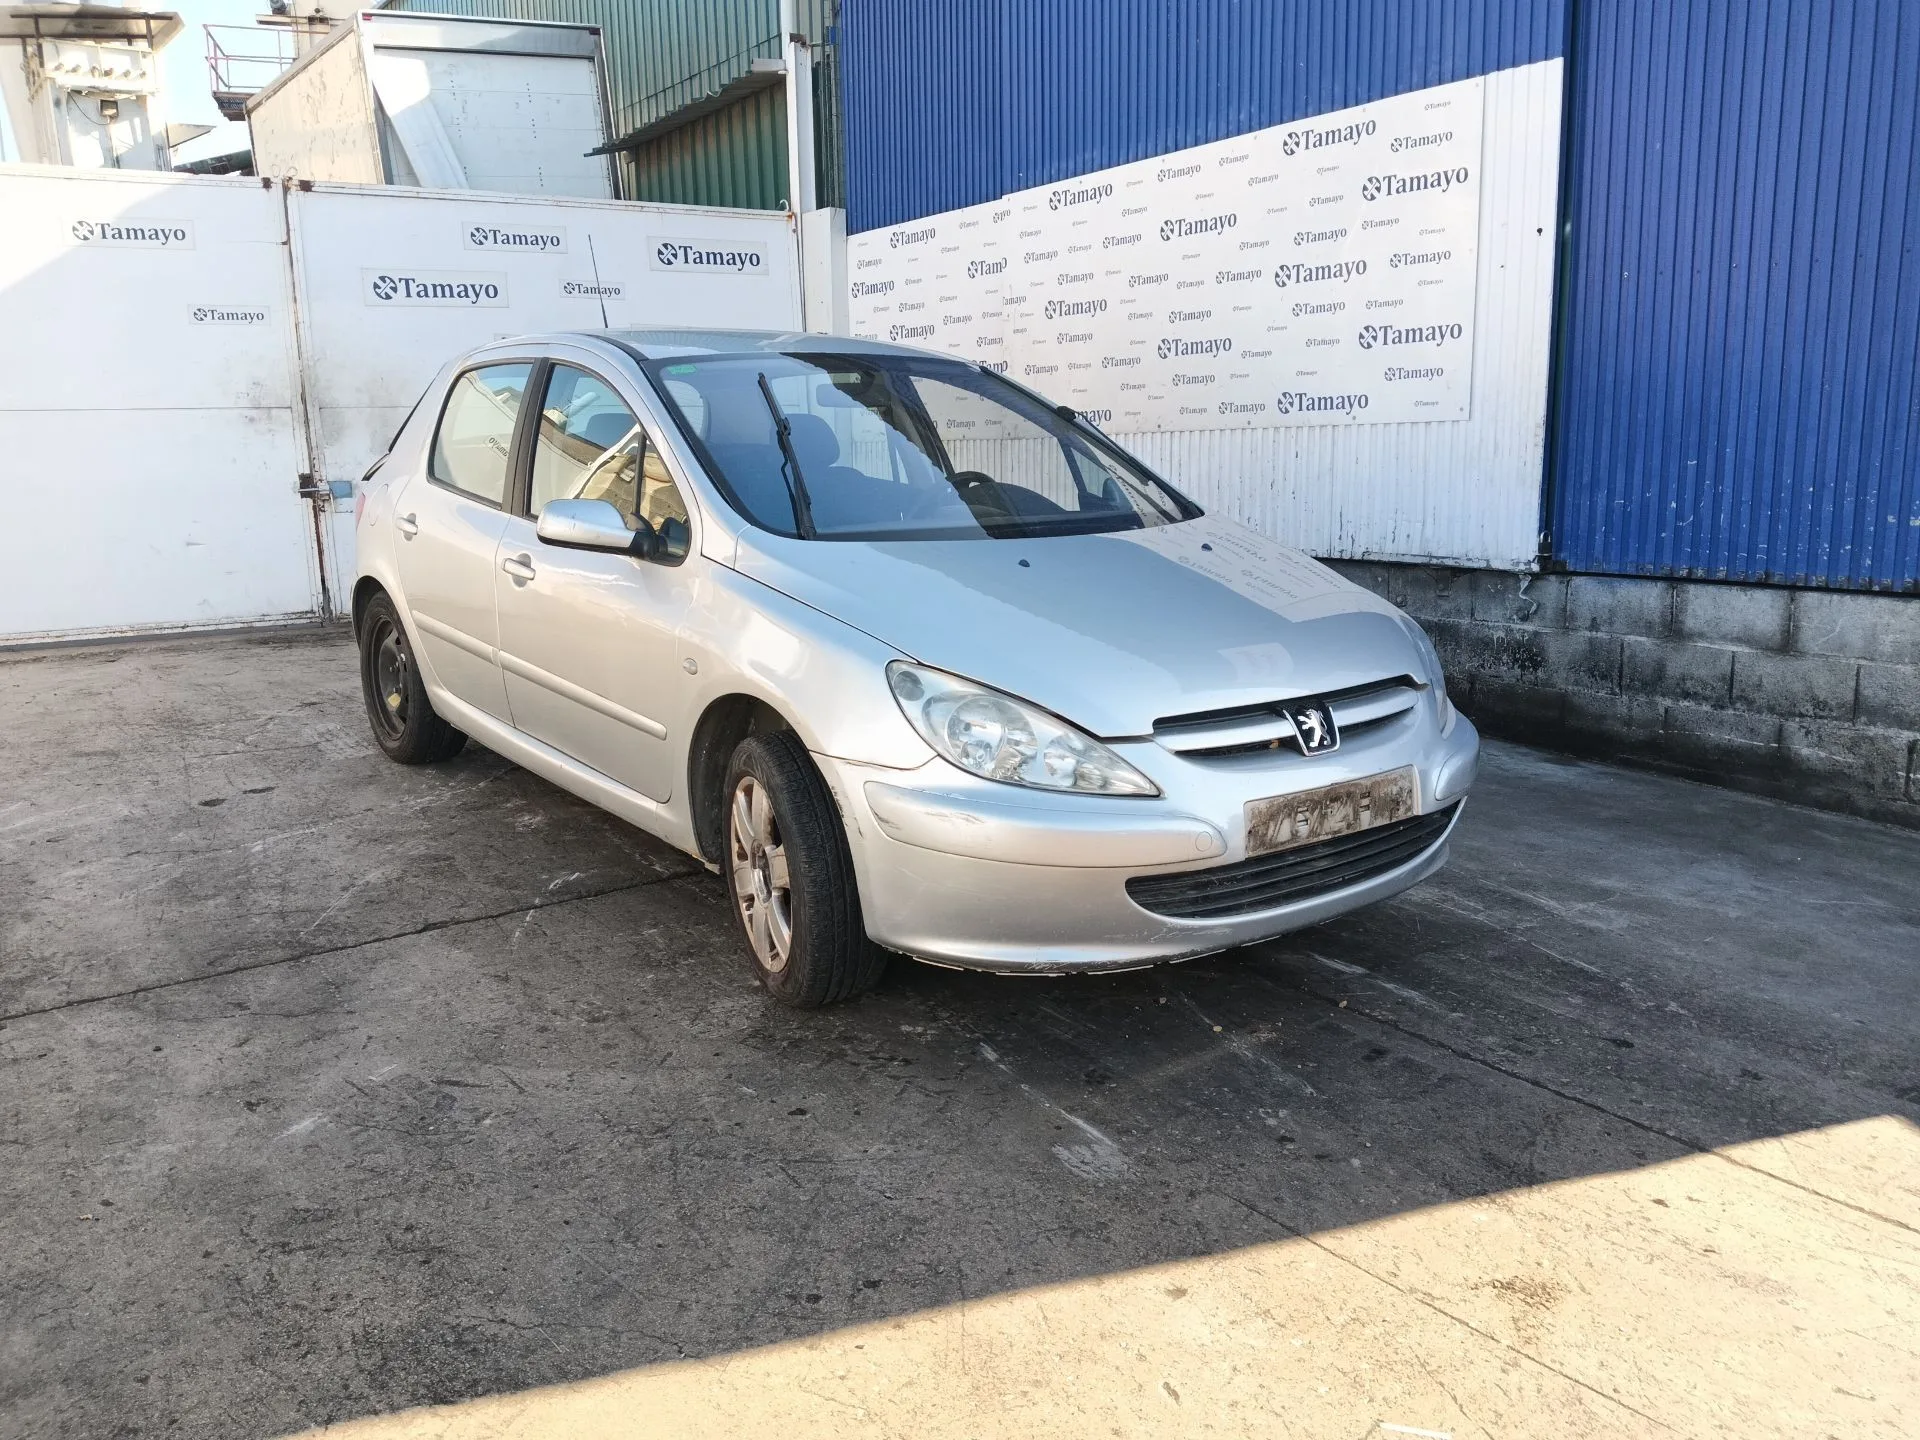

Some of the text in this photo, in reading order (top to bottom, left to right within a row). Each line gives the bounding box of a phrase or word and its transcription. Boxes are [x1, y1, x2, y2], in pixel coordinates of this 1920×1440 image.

[1430, 101, 1451, 110] Tamayo
[1301, 119, 1376, 151] Tamayo
[1402, 131, 1453, 150] Tamayo
[1225, 153, 1249, 165] Tamayo
[1166, 164, 1201, 180] Tamayo
[1255, 173, 1279, 185] Tamayo
[1382, 166, 1469, 196] Tamayo
[1062, 183, 1113, 207] Tamayo
[1316, 195, 1344, 206] Tamayo
[1127, 206, 1148, 216] Tamayo
[1175, 213, 1237, 238] Tamayo
[1368, 217, 1400, 229] Tamayo
[95, 223, 186, 245] Tamayo
[489, 229, 560, 250] Tamayo
[900, 227, 936, 246] Tamayo
[1025, 229, 1041, 238] Tamayo
[1111, 233, 1142, 246] Tamayo
[1303, 228, 1347, 243] Tamayo
[1073, 244, 1092, 252] Tamayo
[1246, 239, 1270, 250] Tamayo
[678, 245, 761, 271] Tamayo
[1032, 250, 1058, 262] Tamayo
[1401, 250, 1451, 266] Tamayo
[862, 258, 882, 268] Tamayo
[1225, 269, 1262, 284] Tamayo
[1292, 259, 1367, 283] Tamayo
[1065, 272, 1094, 285] Tamayo
[1137, 273, 1169, 286] Tamayo
[1182, 279, 1205, 288] Tamayo
[398, 277, 499, 304] Tamayo
[575, 283, 621, 298] Tamayo
[860, 280, 894, 296] Tamayo
[904, 302, 925, 311] Tamayo
[1057, 299, 1107, 318] Tamayo
[1302, 301, 1346, 315] Tamayo
[1372, 299, 1404, 309] Tamayo
[208, 309, 265, 324] Tamayo
[948, 314, 972, 326] Tamayo
[1132, 311, 1153, 320] Tamayo
[1177, 309, 1212, 322] Tamayo
[899, 324, 935, 340] Tamayo
[1065, 332, 1093, 344] Tamayo
[1379, 322, 1462, 347] Tamayo
[983, 337, 1003, 346] Tamay
[1172, 337, 1232, 358] Tamayo
[1312, 338, 1340, 347] Tamayo
[1248, 350, 1272, 359] Tamayo
[1073, 362, 1091, 370] Tamayo
[1110, 357, 1141, 370] Tamayo
[1032, 365, 1058, 377] Tamayo
[1395, 367, 1444, 381] Tamayo
[1181, 374, 1215, 386] Tamayo
[1126, 383, 1146, 391] Tamayo
[1228, 402, 1265, 414] Tamayo
[1294, 392, 1369, 415] Tamayo
[1185, 407, 1207, 416] Tamayo
[952, 419, 976, 430] Tamayo
